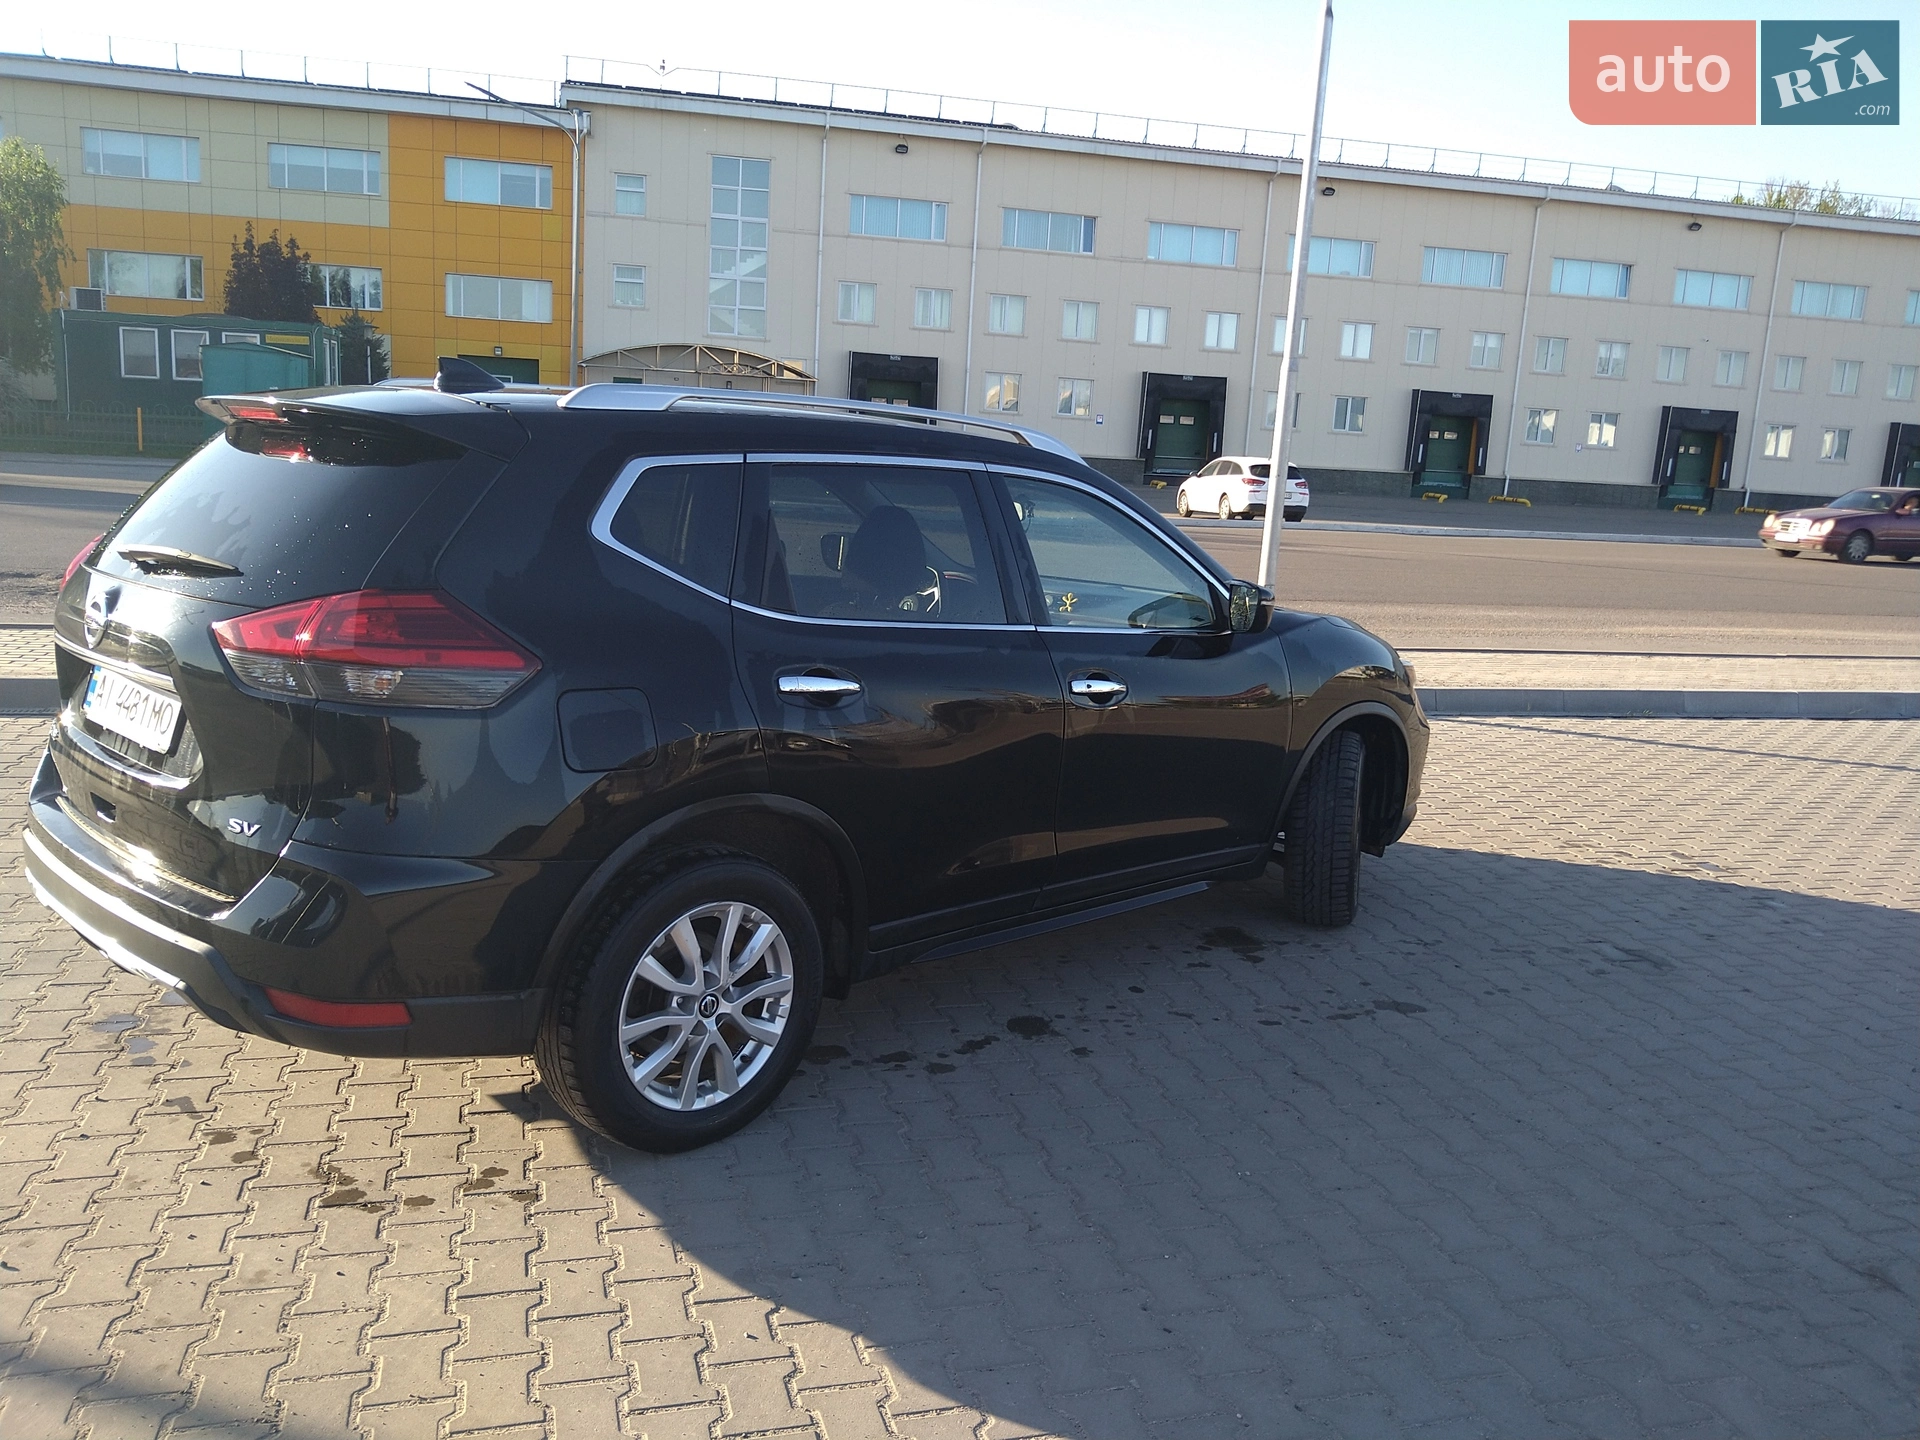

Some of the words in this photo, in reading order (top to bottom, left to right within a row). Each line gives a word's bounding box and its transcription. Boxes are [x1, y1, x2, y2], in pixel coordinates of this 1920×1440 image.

[96, 675, 115, 710] AI
[115, 684, 151, 726] 4481
[147, 697, 174, 735] MO
[227, 817, 262, 837] SV
